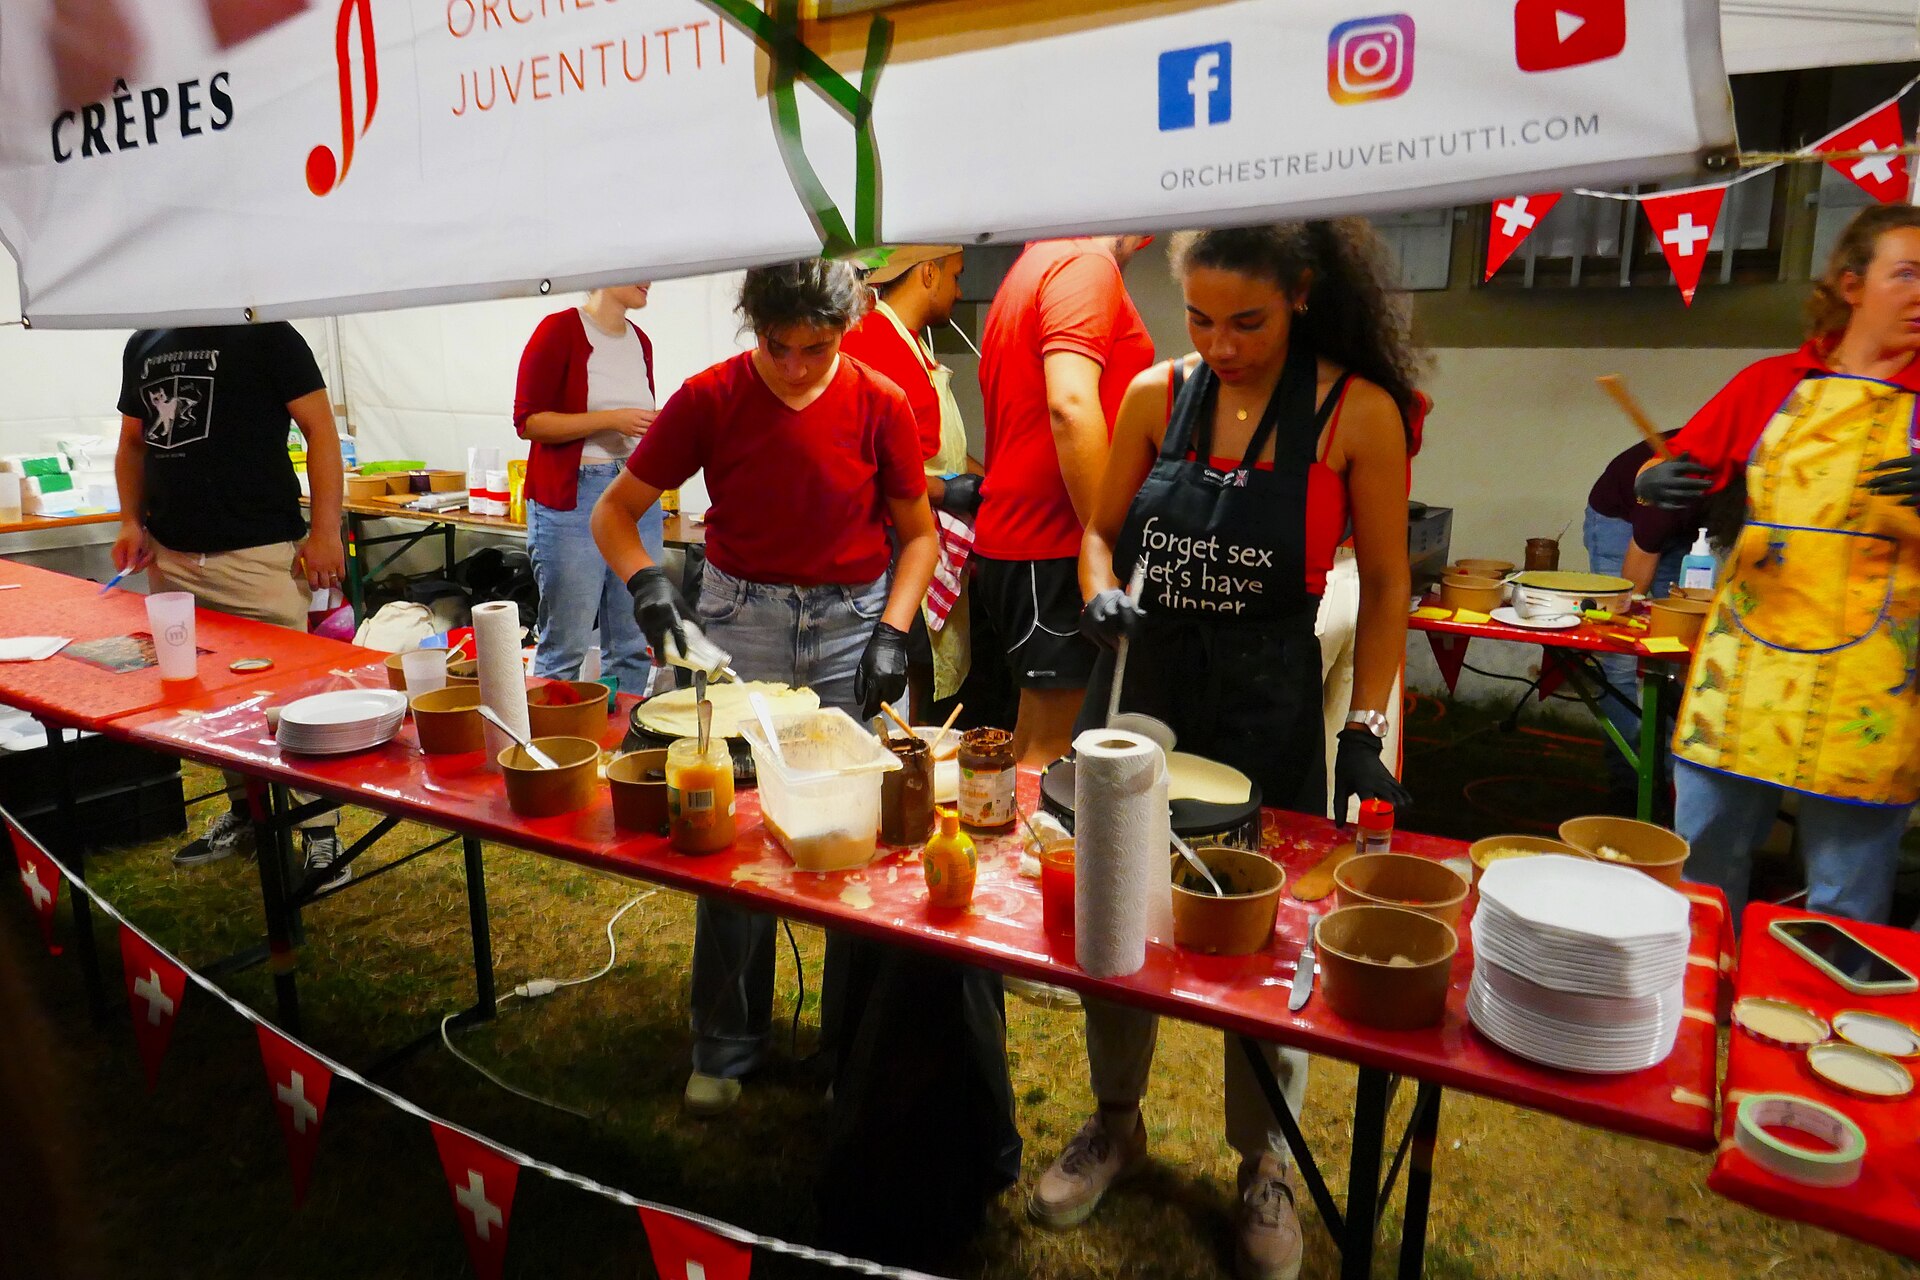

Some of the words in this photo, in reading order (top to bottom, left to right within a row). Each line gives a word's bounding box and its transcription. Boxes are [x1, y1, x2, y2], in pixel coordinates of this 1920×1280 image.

[447, 0, 618, 38] ORC
[452, 16, 726, 117] JUVENTUTTI
[51, 71, 235, 164] CRÊPES
[1159, 114, 1601, 192] ORCHESTREJUVENTUTTI.COM
[1142, 516, 1220, 566] forget
[1227, 544, 1274, 569] sex
[1158, 584, 1246, 615] dinner
[1201, 562, 1264, 596] have
